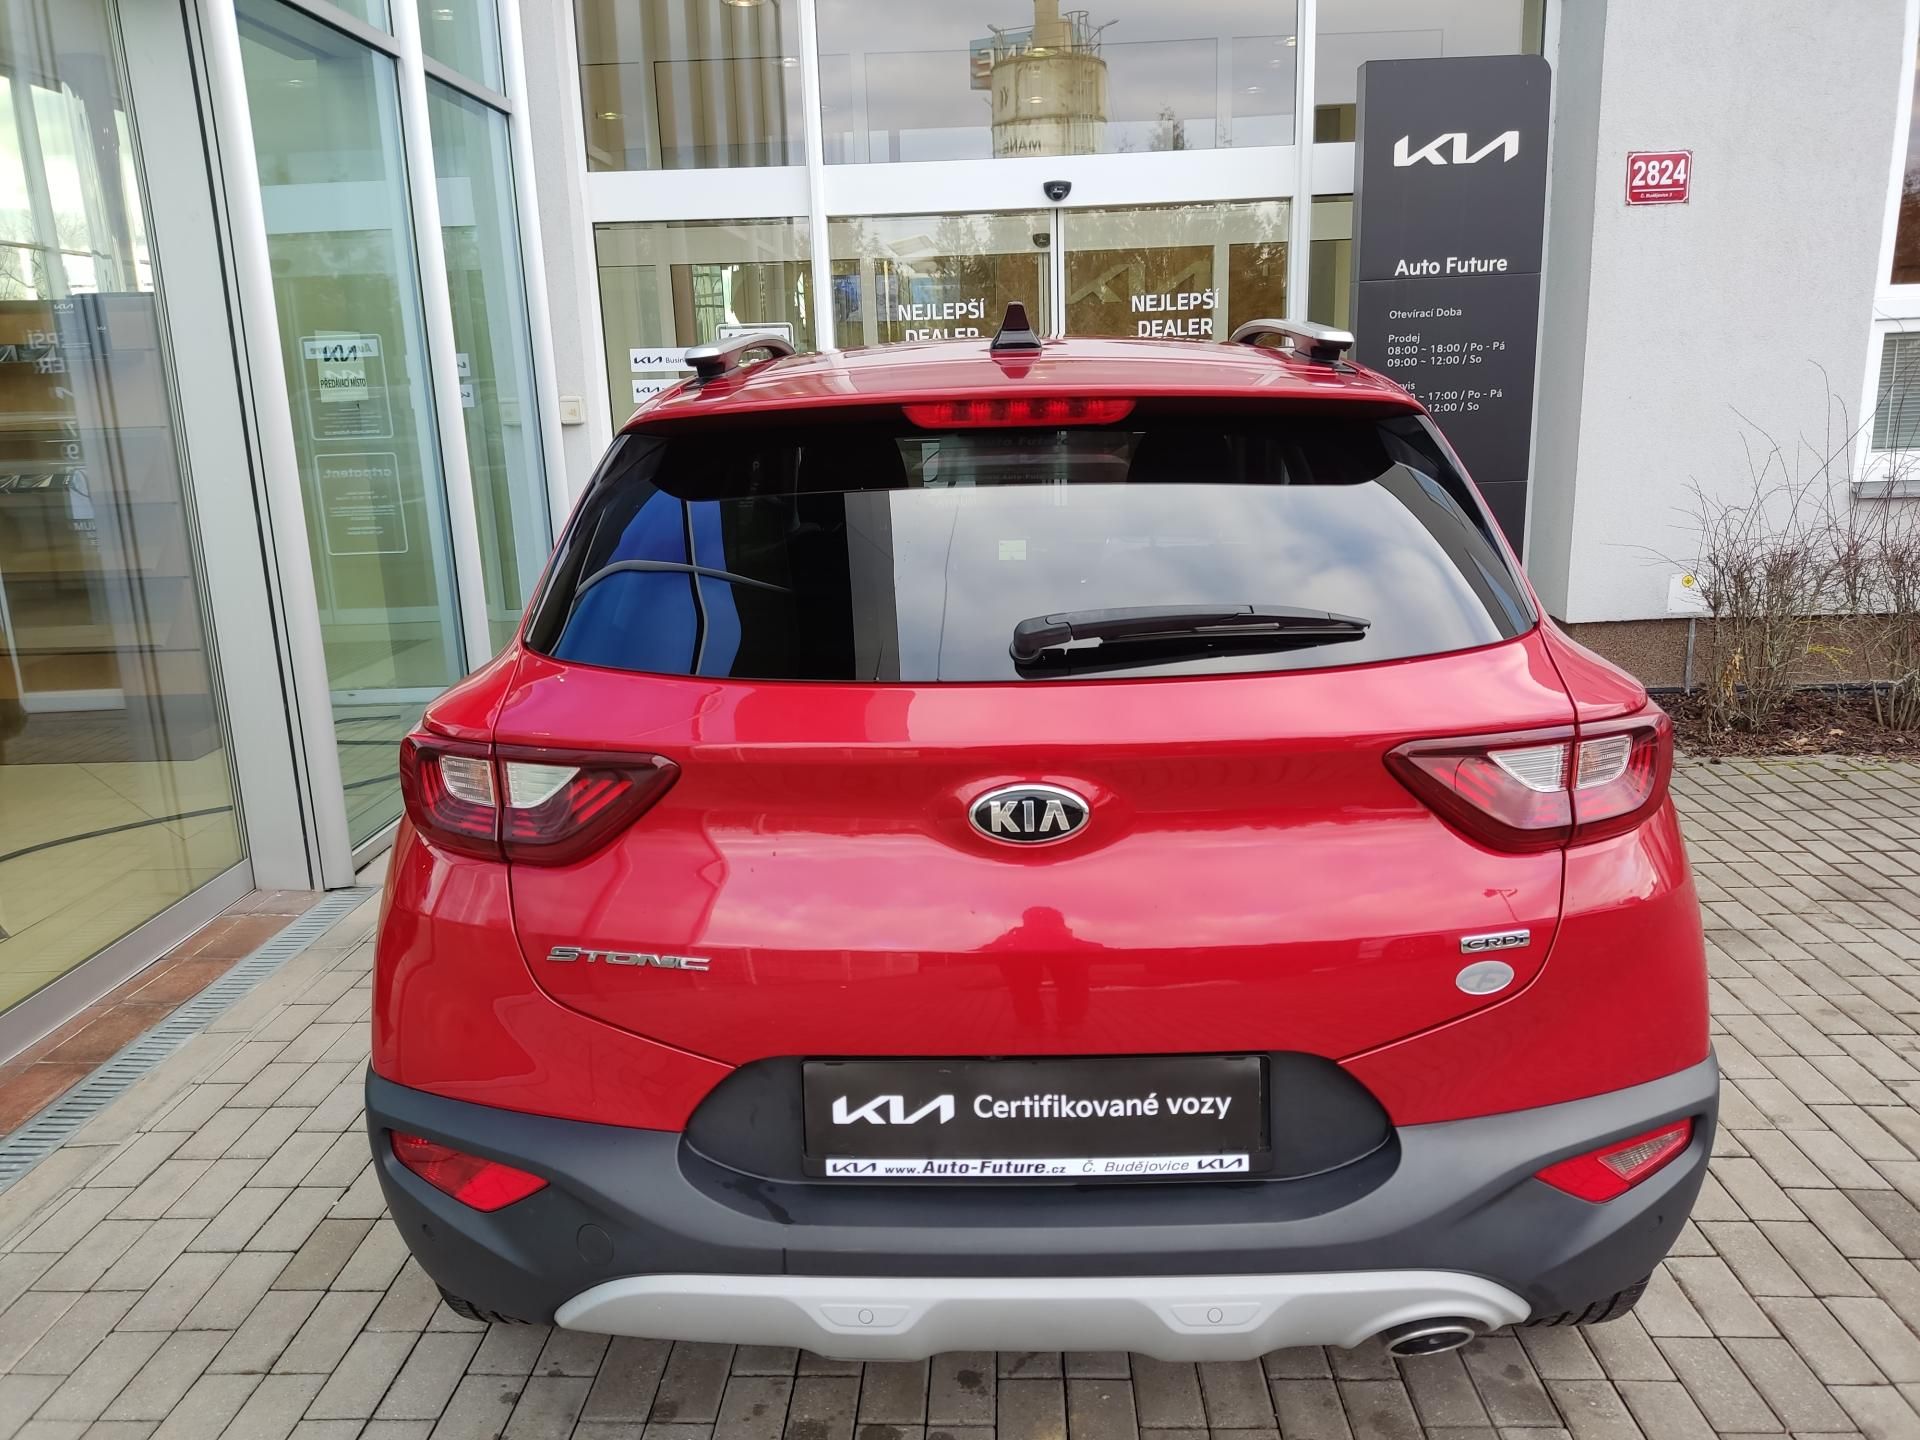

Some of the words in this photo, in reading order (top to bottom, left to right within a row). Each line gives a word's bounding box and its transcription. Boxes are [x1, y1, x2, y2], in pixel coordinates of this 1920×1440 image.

[1393, 130, 1519, 167] KIA
[1632, 159, 1686, 186] 2824
[1394, 259, 1441, 276] Auto
[1446, 257, 1508, 274] Future
[1131, 288, 1219, 312] NEJLEPŠÍ
[898, 298, 985, 321] NEJLEPŠÍ
[1389, 309, 1434, 319] Otevírací
[1436, 307, 1462, 317] Doba
[1138, 317, 1213, 337] DEALER
[1388, 333, 1421, 344] Prodej
[1387, 345, 1418, 355] 08:00
[1430, 343, 1460, 353] 18:00
[1462, 342, 1468, 352] /
[1470, 342, 1483, 351] Po
[1492, 341, 1505, 350] Pá
[633, 356, 662, 364] KIA
[665, 356, 686, 364] Busin
[1387, 357, 1418, 367] 09:00
[1430, 356, 1459, 365] 12:00
[1462, 354, 1467, 365] /
[1469, 354, 1482, 364] So
[636, 386, 659, 394] KIA
[1428, 391, 1458, 401] 17:00
[1460, 390, 1465, 400] /
[1468, 390, 1480, 399] Po
[1490, 388, 1503, 398] Pá
[1428, 402, 1457, 413] 12:00
[1459, 402, 1464, 412] /
[1467, 401, 1479, 411] So
[990, 800, 1071, 833] KIA
[1467, 933, 1526, 949] CRDi
[546, 946, 712, 971] STONIC
[832, 1094, 955, 1125] KIA
[973, 1092, 1159, 1119] Certifikované
[1166, 1096, 1232, 1120] vozy
[832, 1162, 877, 1173] KIA
[884, 1160, 1066, 1174] www.Auto-Future.cz
[1082, 1159, 1096, 1173] Č.
[1104, 1160, 1190, 1174] Budějovice
[1197, 1158, 1243, 1170] KIA
